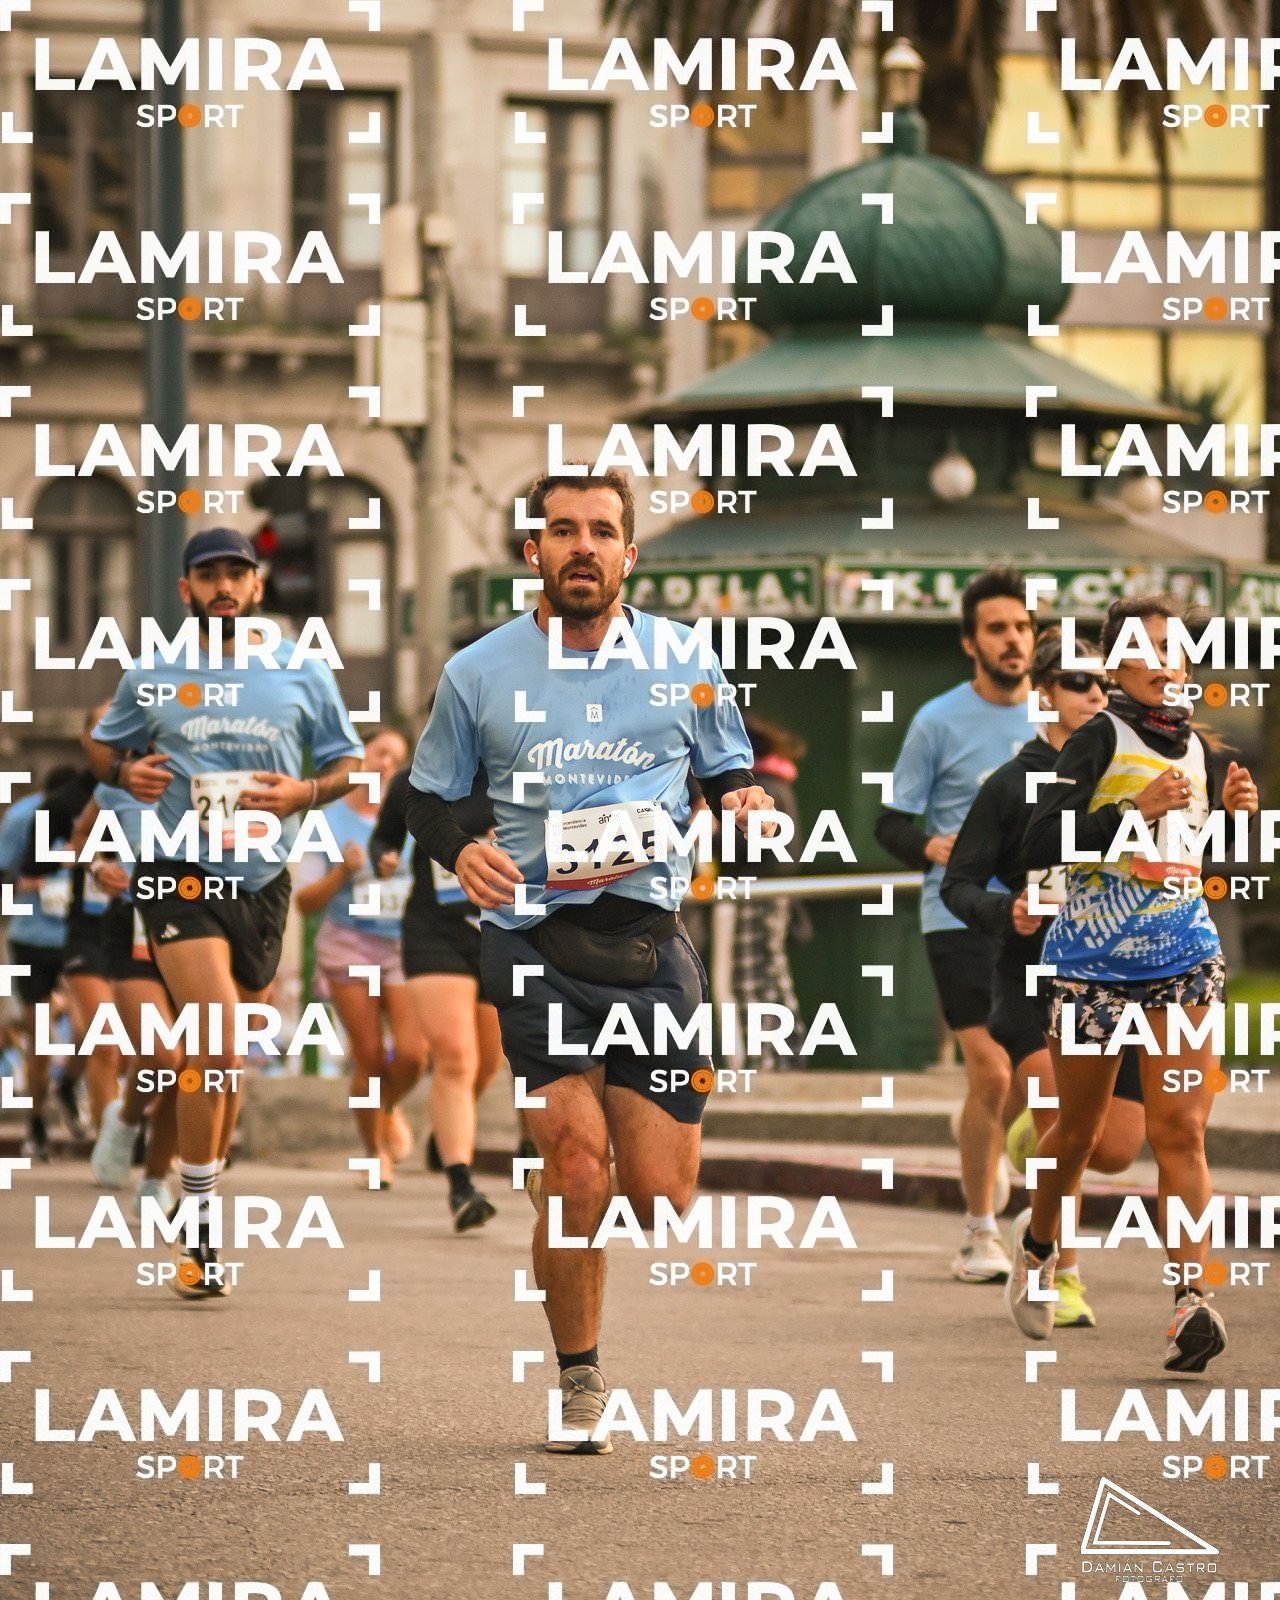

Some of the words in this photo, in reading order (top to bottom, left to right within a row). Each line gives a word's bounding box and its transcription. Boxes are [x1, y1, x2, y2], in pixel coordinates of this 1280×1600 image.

[181, 715, 279, 742] Maratón
[527, 737, 656, 770] Maratón
[543, 773, 639, 785] MONTEVID
[197, 795, 240, 821] 21
